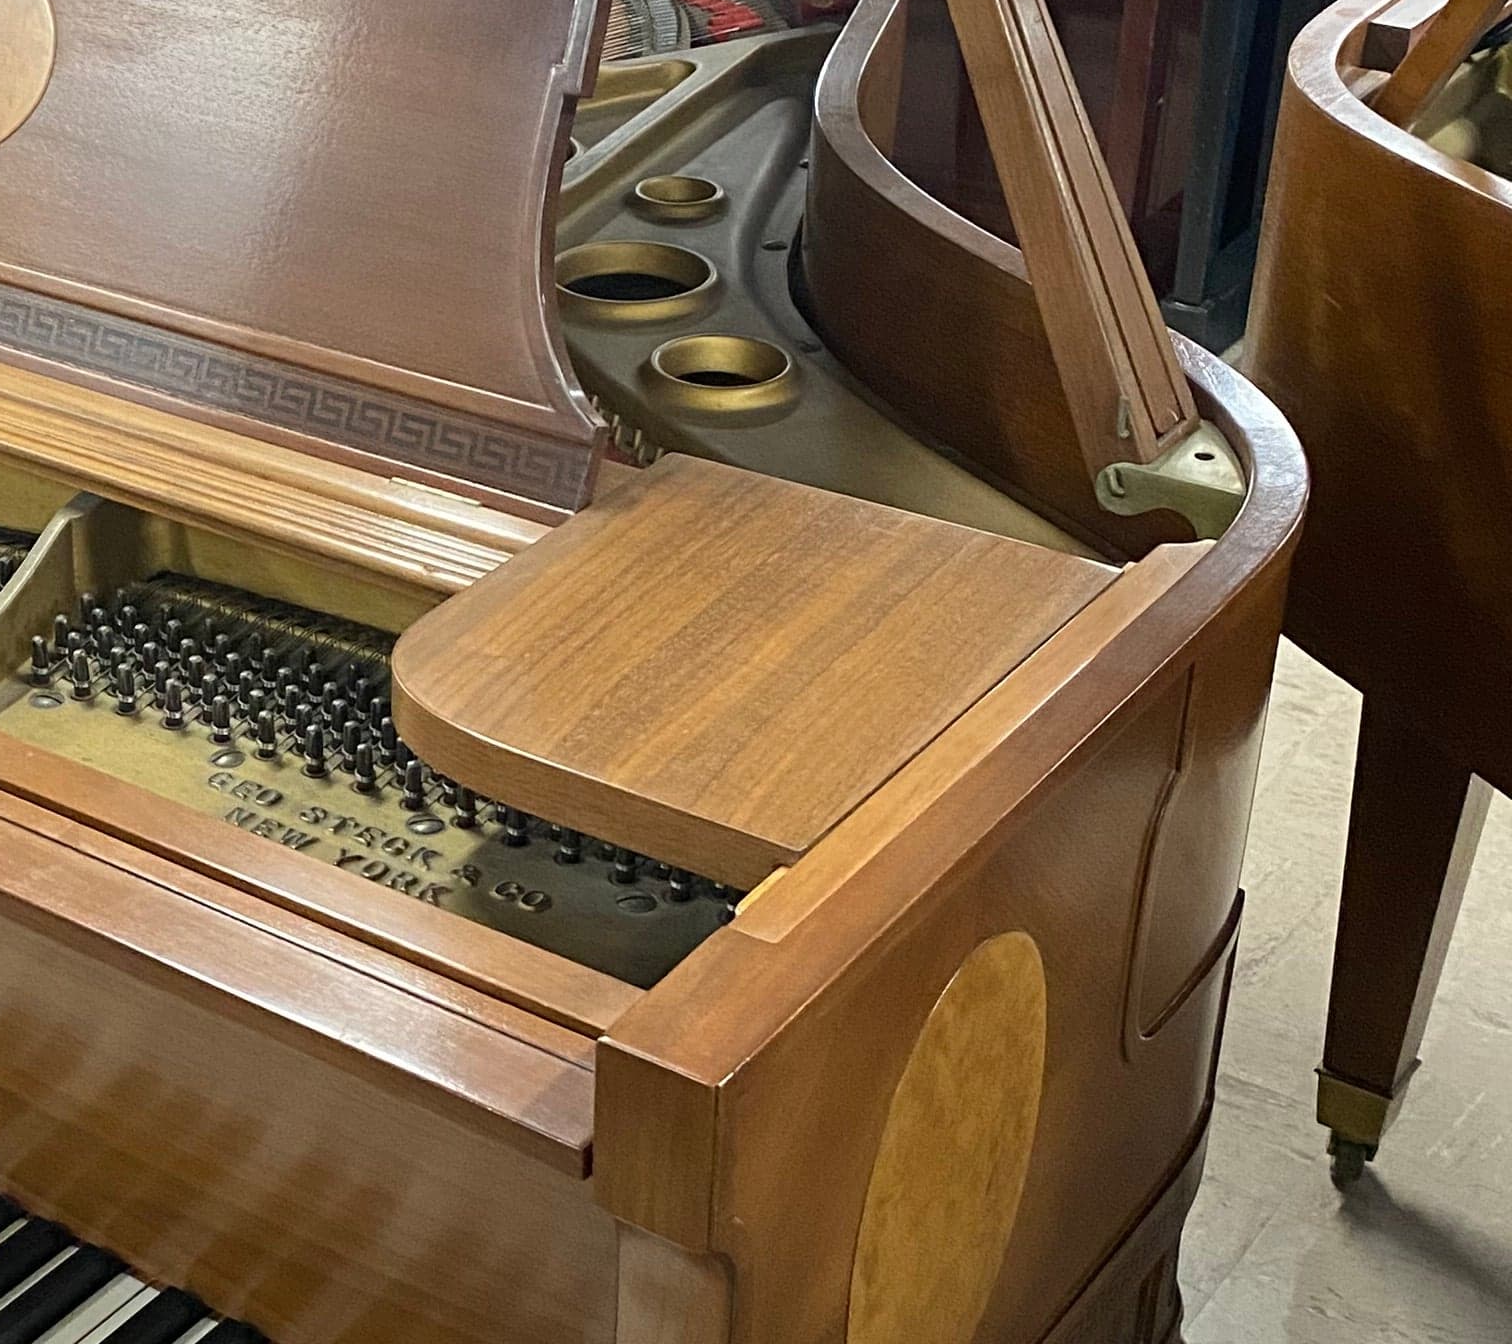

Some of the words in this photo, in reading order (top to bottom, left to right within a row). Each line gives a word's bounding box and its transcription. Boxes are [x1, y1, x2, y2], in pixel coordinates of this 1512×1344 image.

[208, 772, 283, 806] GEO
[299, 807, 442, 871] STECK
[224, 807, 319, 850] NEW
[335, 849, 452, 905] YORK
